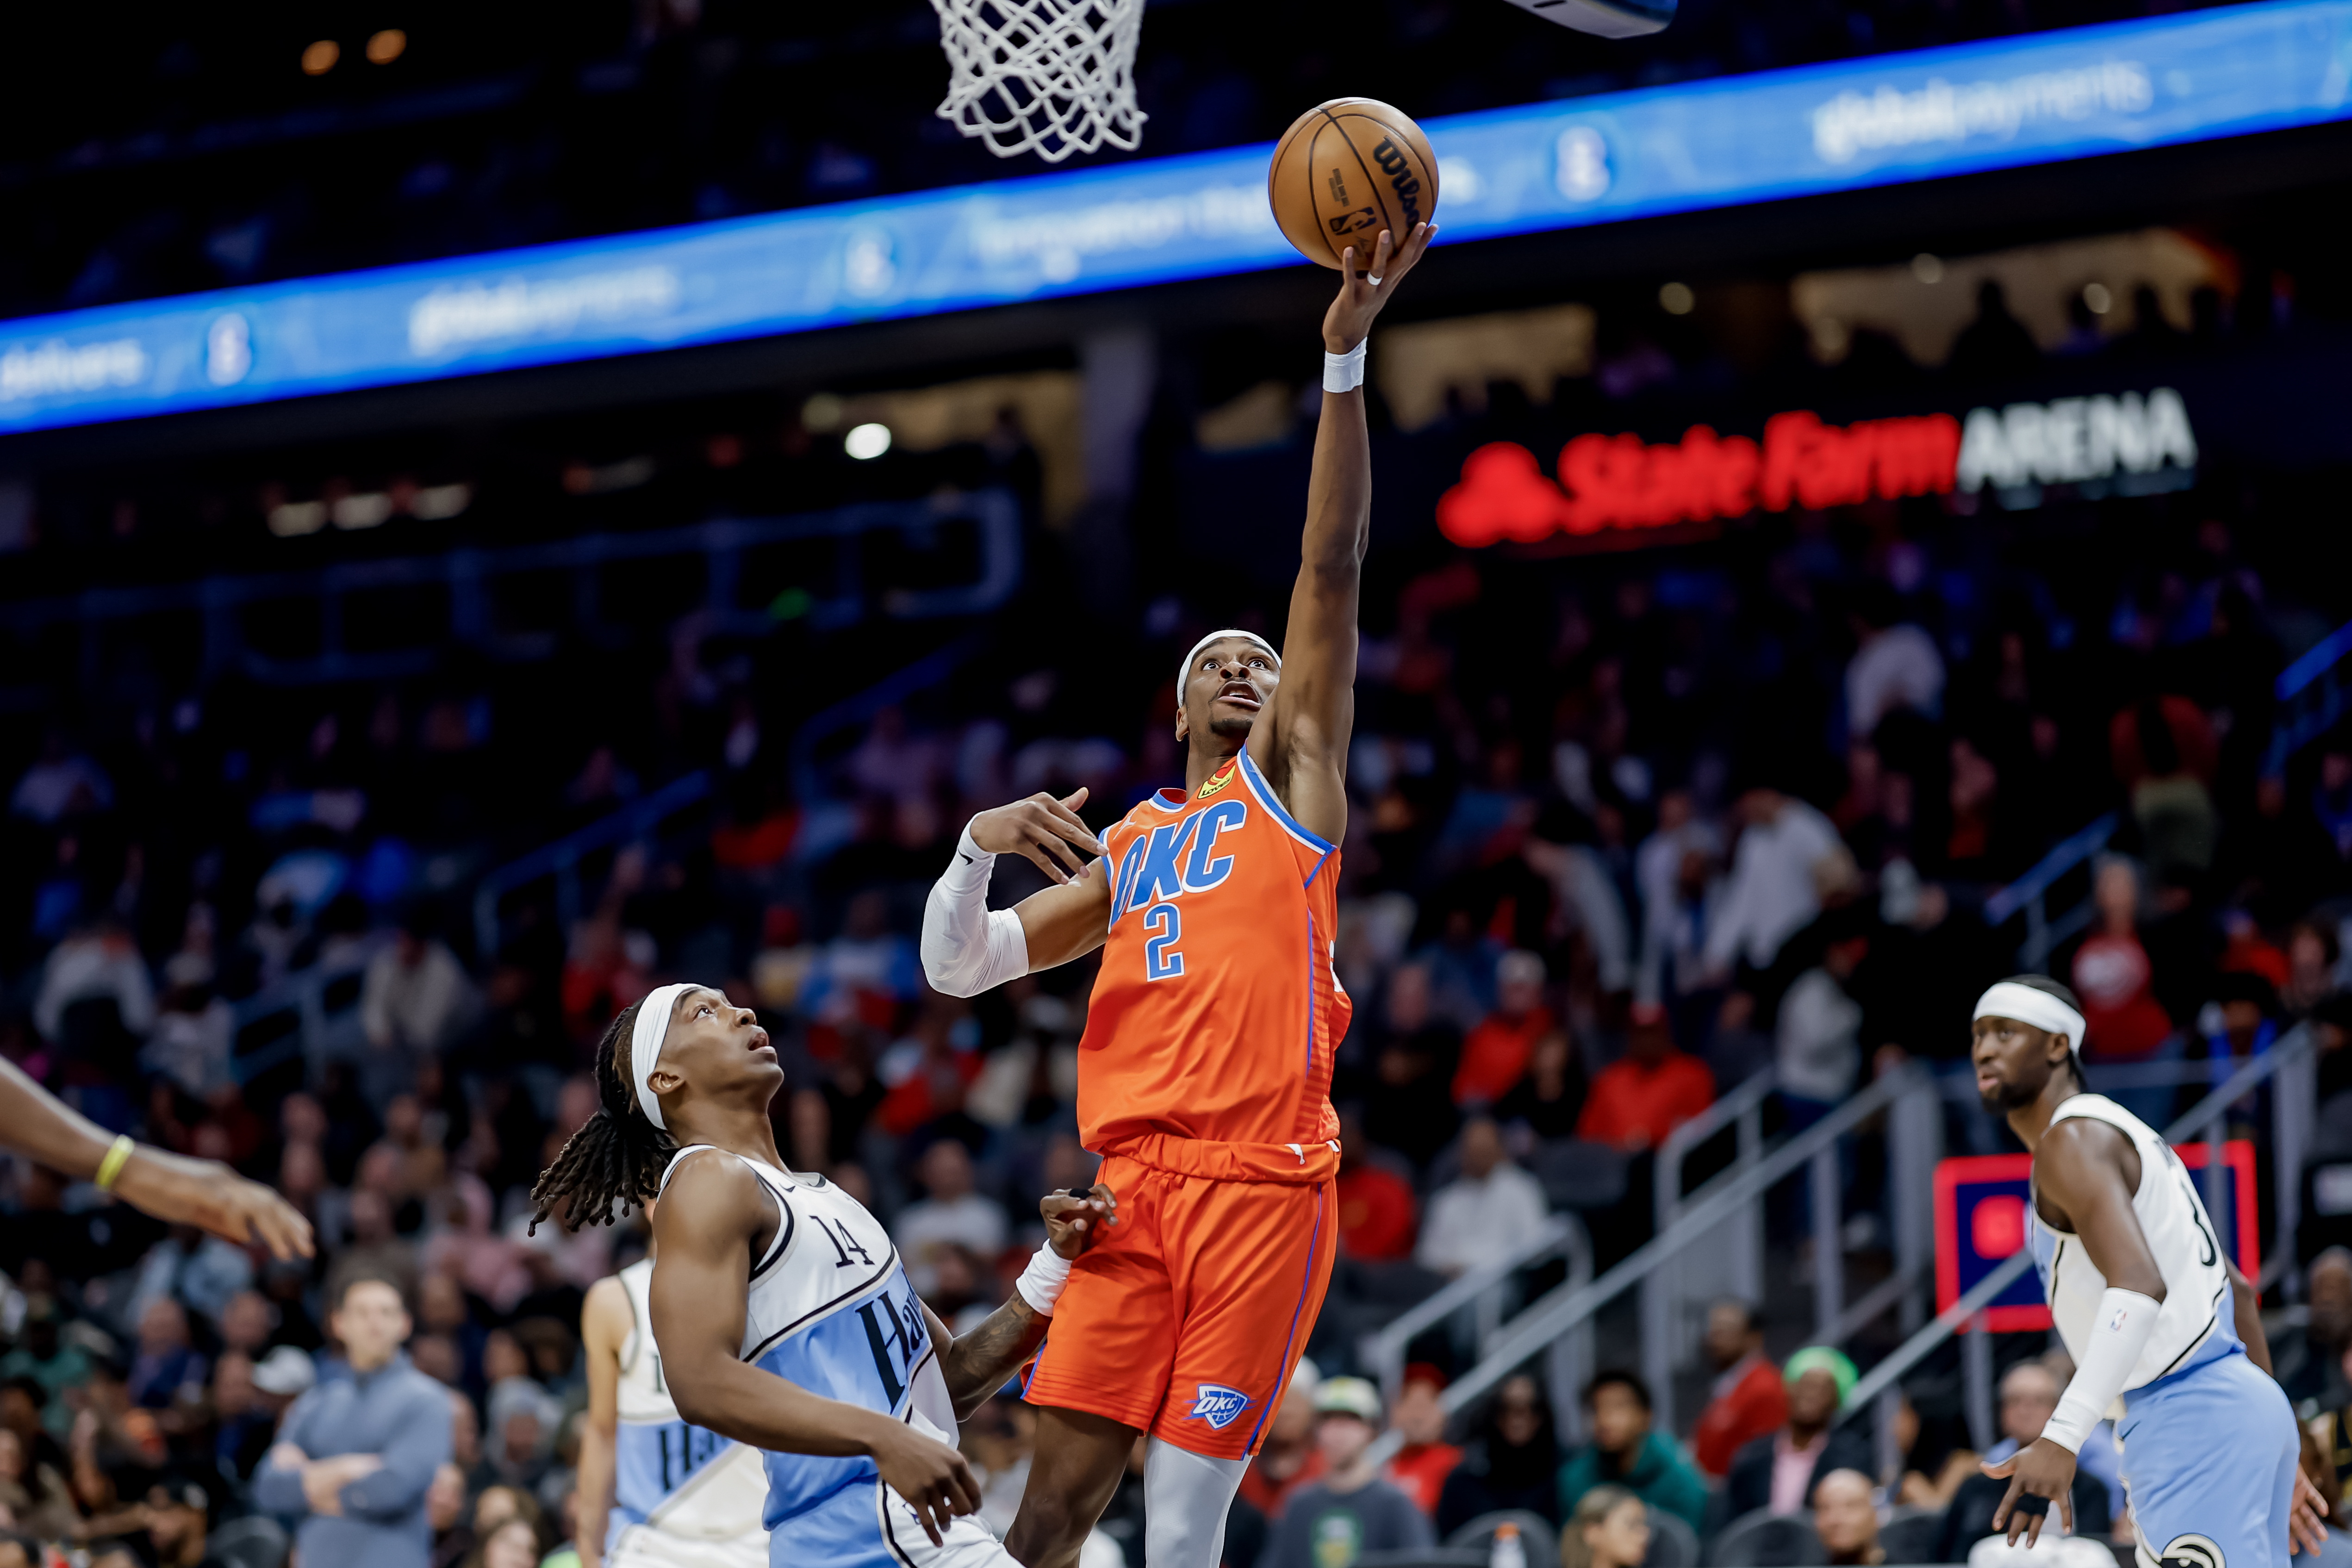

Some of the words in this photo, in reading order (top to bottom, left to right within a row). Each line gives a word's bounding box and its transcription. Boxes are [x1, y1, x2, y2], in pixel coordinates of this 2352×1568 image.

[1374, 135, 1420, 230] Wilso
[1557, 431, 1760, 535] State
[1763, 410, 1960, 512] Farm
[1957, 387, 2198, 493] ARENA
[1108, 799, 1247, 934] OKC
[1144, 902, 1184, 982] 2
[809, 1215, 875, 1268] 14
[855, 1266, 924, 1413] Haw
[1193, 1395, 1238, 1414] OKC
